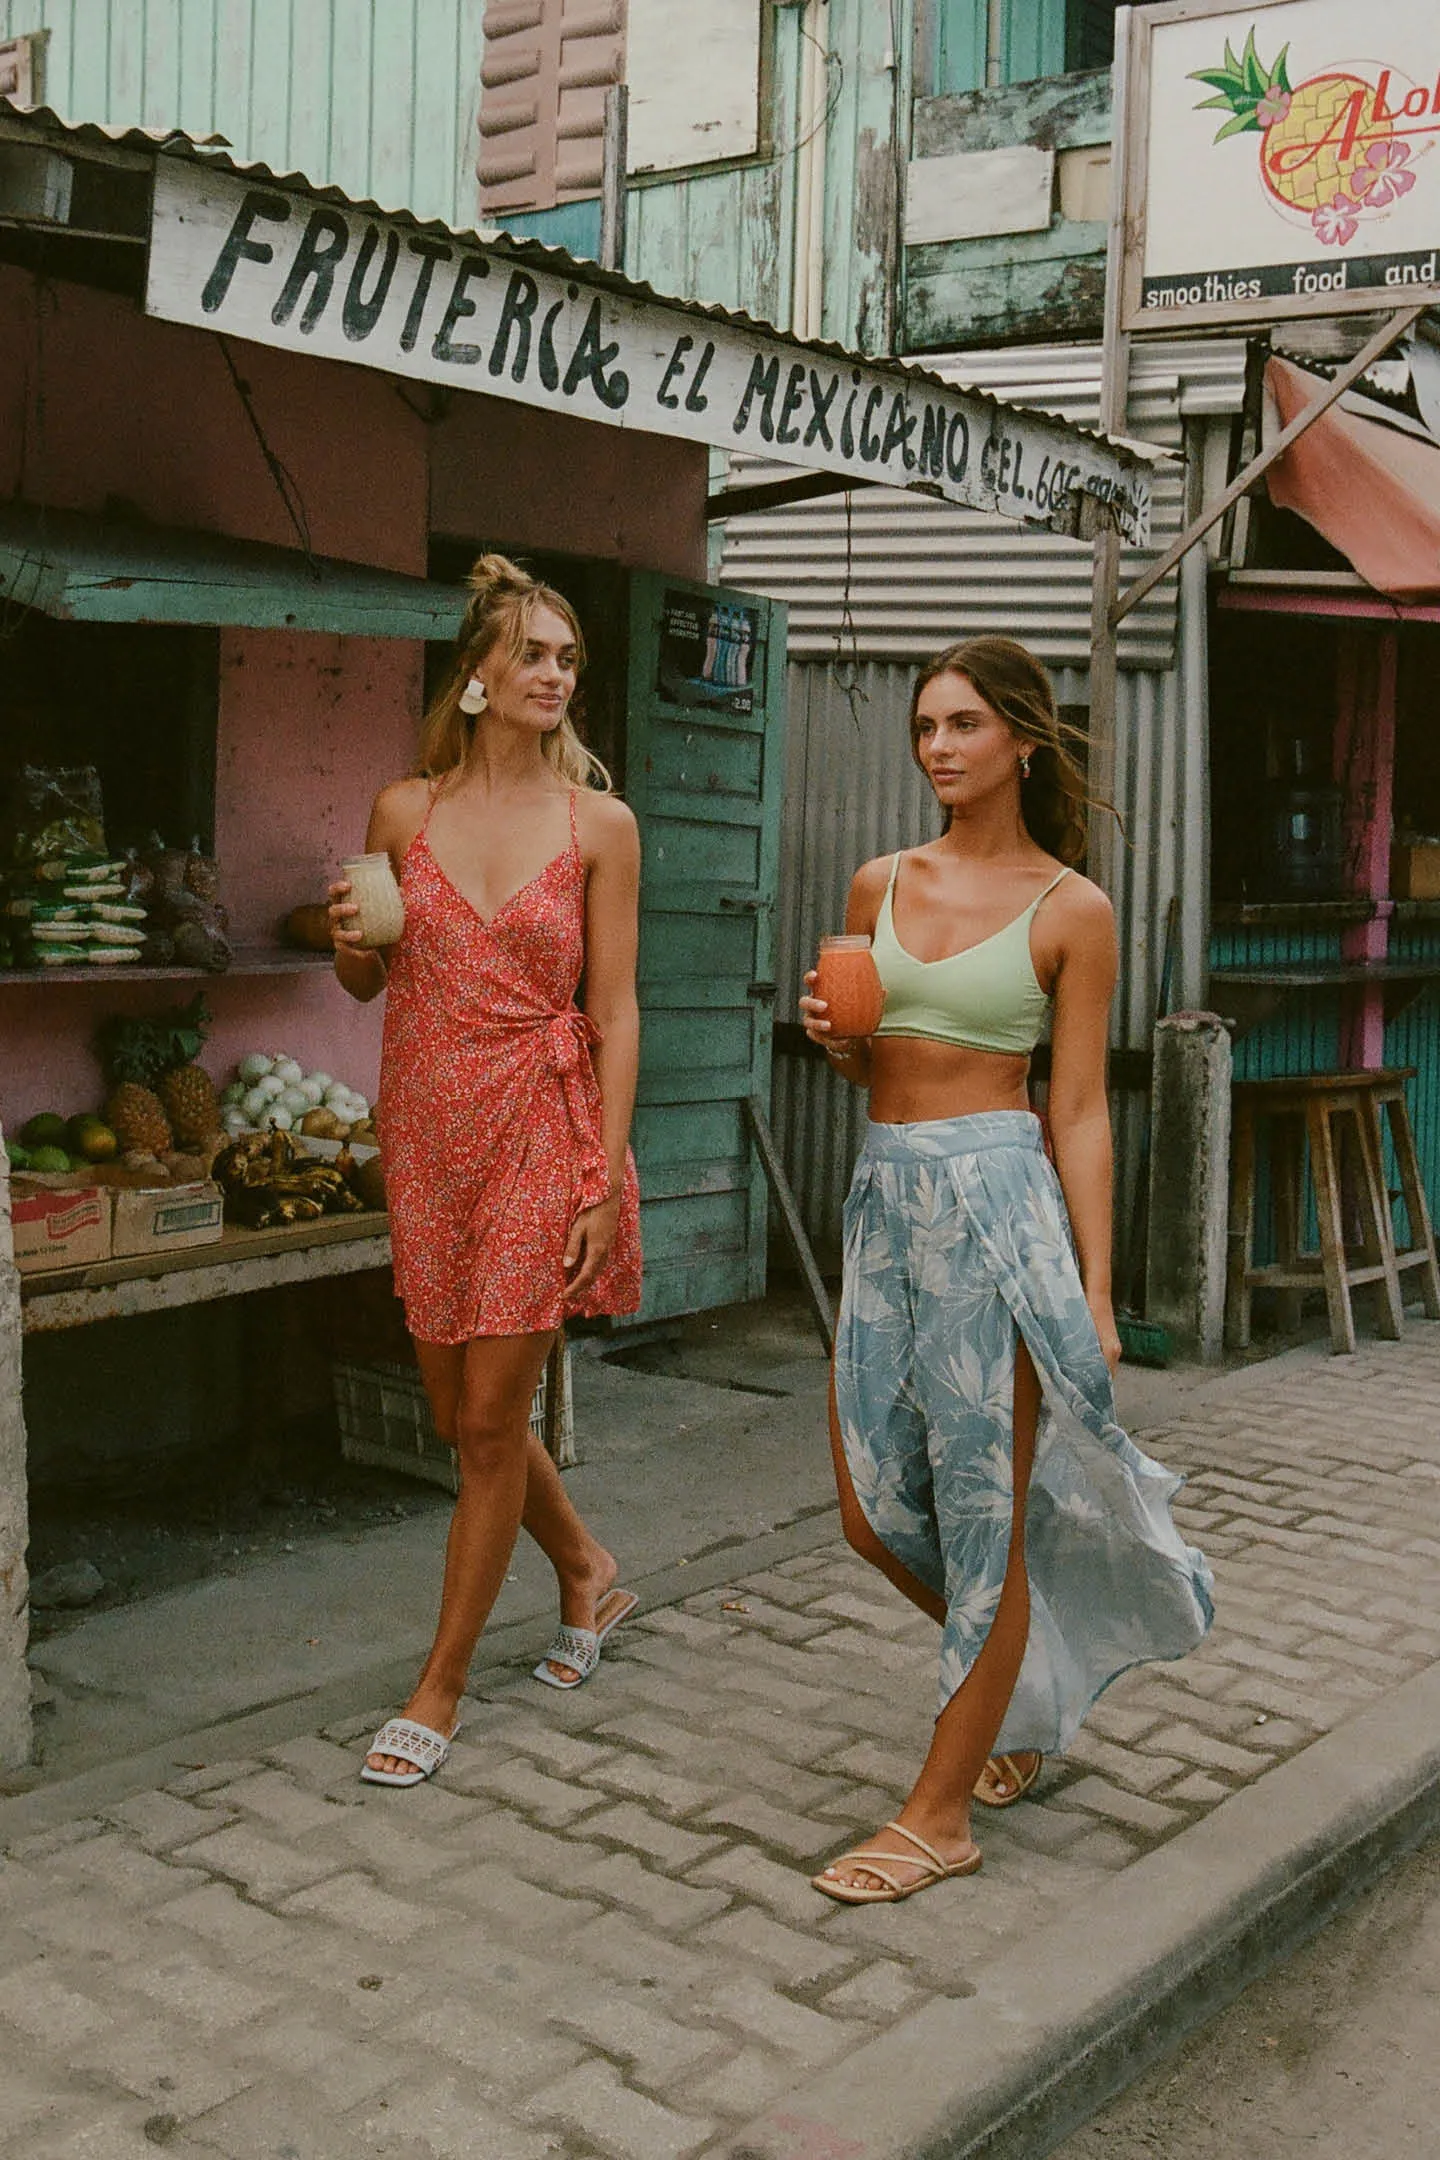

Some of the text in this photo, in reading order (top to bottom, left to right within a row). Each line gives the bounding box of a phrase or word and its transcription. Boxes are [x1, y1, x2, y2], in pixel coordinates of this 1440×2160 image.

[1269, 69, 1440, 175] ALo
[1146, 252, 1436, 308] smoothies food and
[656, 335, 715, 413] EL
